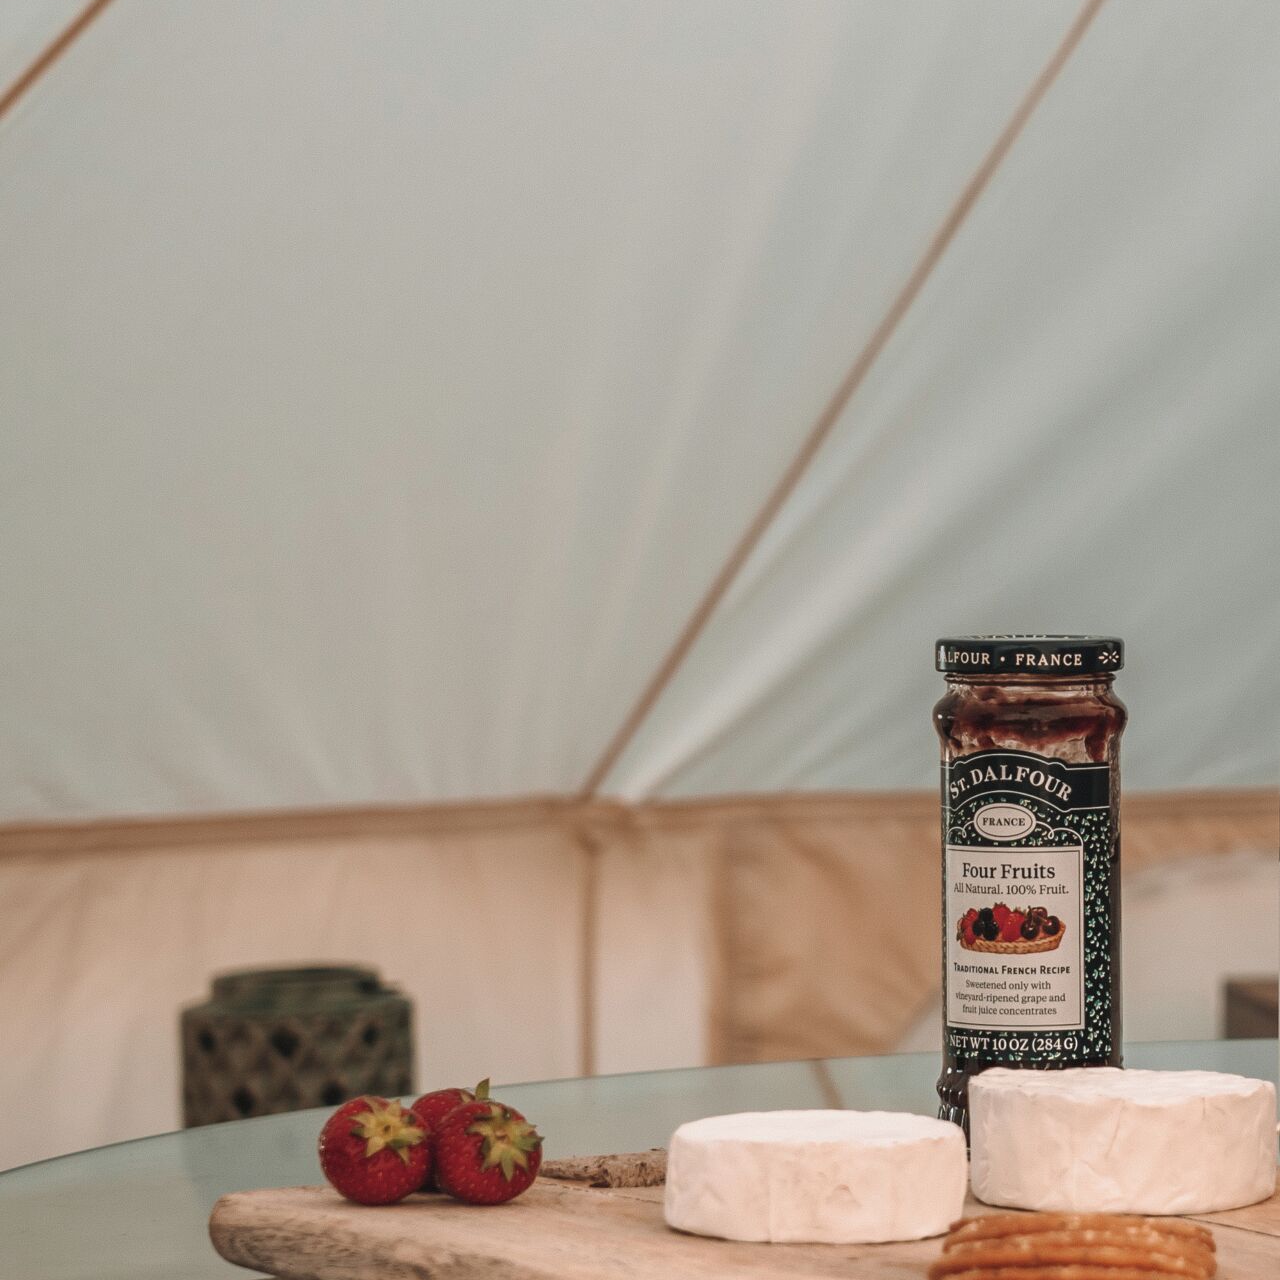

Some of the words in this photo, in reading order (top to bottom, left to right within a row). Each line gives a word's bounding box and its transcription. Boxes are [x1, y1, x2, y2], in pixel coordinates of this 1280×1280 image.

[1015, 653, 1083, 666] FRANCE
[969, 764, 1072, 801] DALFOUR
[982, 817, 1026, 826] FRANCE
[962, 862, 997, 879] Four
[1000, 863, 1056, 879] Fruits
[954, 882, 964, 893] All
[965, 883, 1003, 895] Natural.
[1006, 884, 1037, 895] 100%
[1039, 884, 1070, 895] Fruit.
[953, 962, 999, 974] TRADITIONAL
[1001, 965, 1037, 975] FRENCH
[1040, 965, 1071, 974] RECIPE
[965, 980, 1007, 990] Sweetened
[1008, 981, 1029, 991] only
[1031, 981, 1052, 990] with
[955, 992, 1019, 1004] vineyard-ripened
[1021, 995, 1047, 1004] grape
[1049, 993, 1066, 1002] and
[962, 1004, 977, 1014] fruit
[978, 1005, 998, 1015] juice
[999, 1006, 1057, 1015] concentrates
[949, 1034, 968, 1048] NET
[969, 1037, 990, 1050] WT
[992, 1038, 1007, 1051] 10
[1009, 1038, 1029, 1051] OZ
